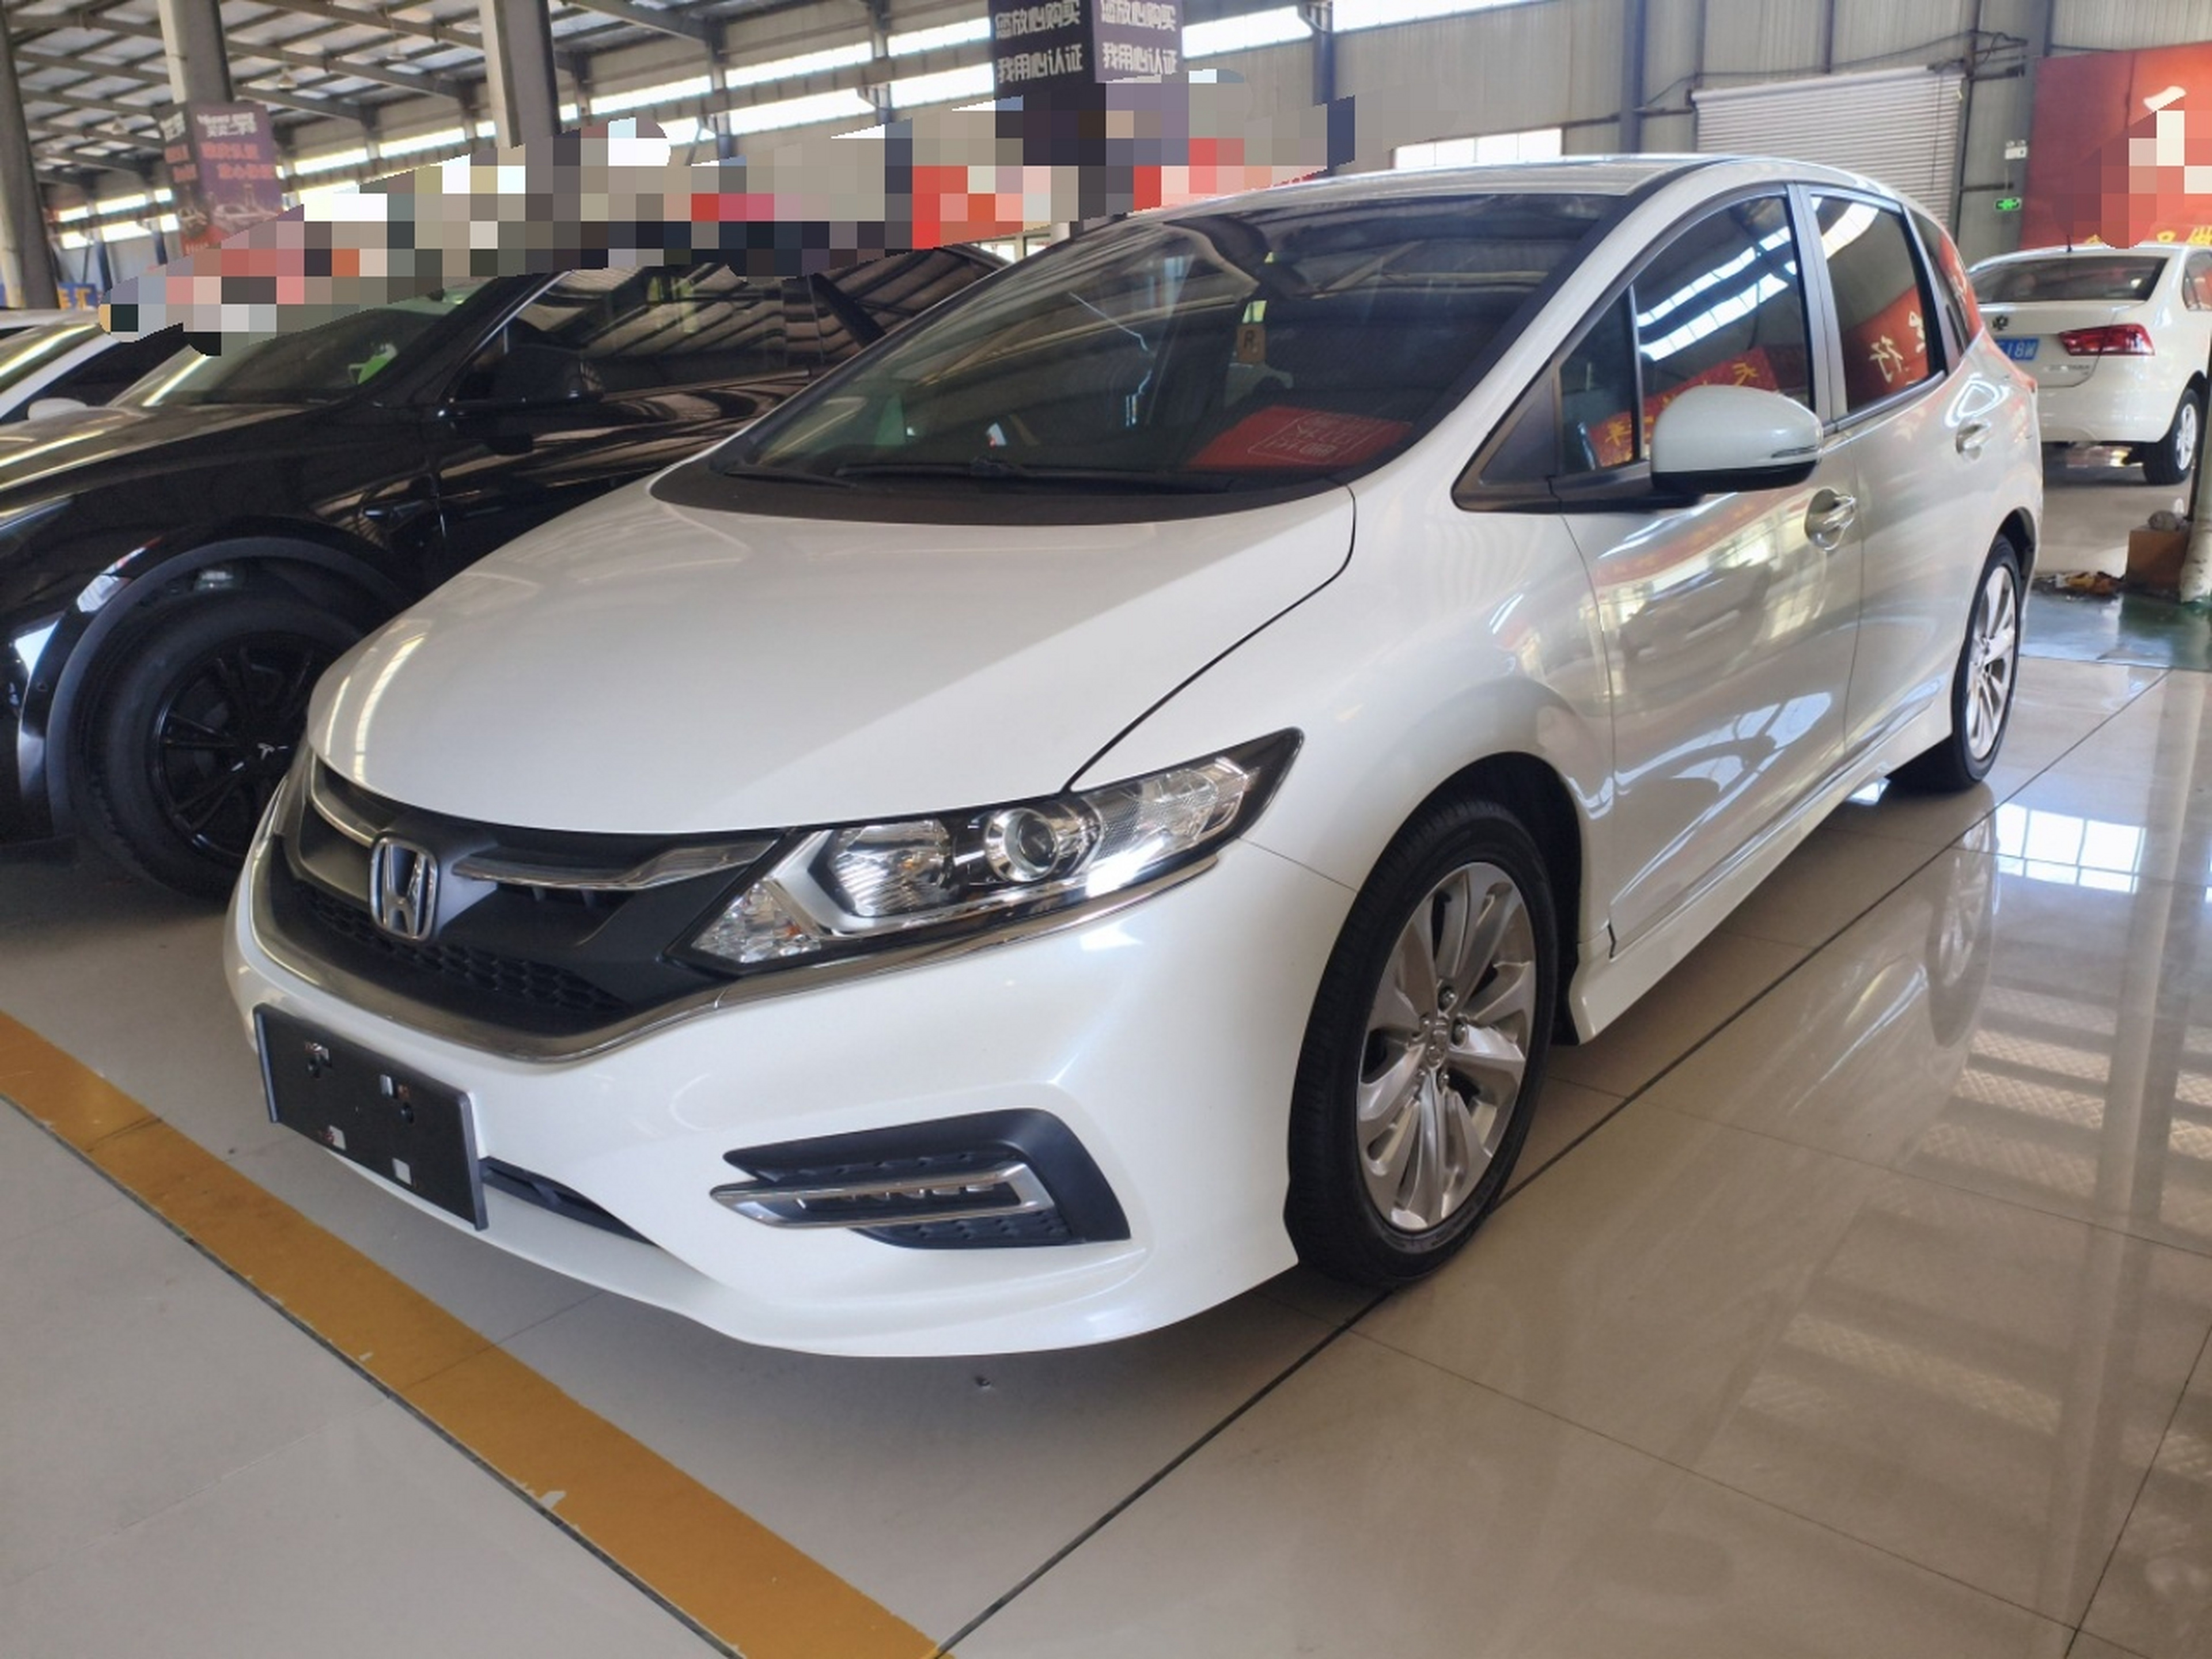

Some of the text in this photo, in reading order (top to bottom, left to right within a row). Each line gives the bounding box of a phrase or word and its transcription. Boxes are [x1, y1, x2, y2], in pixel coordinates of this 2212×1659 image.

[997, 43, 1083, 84] 我用心认证
[1103, 41, 1178, 75] 我用心认证
